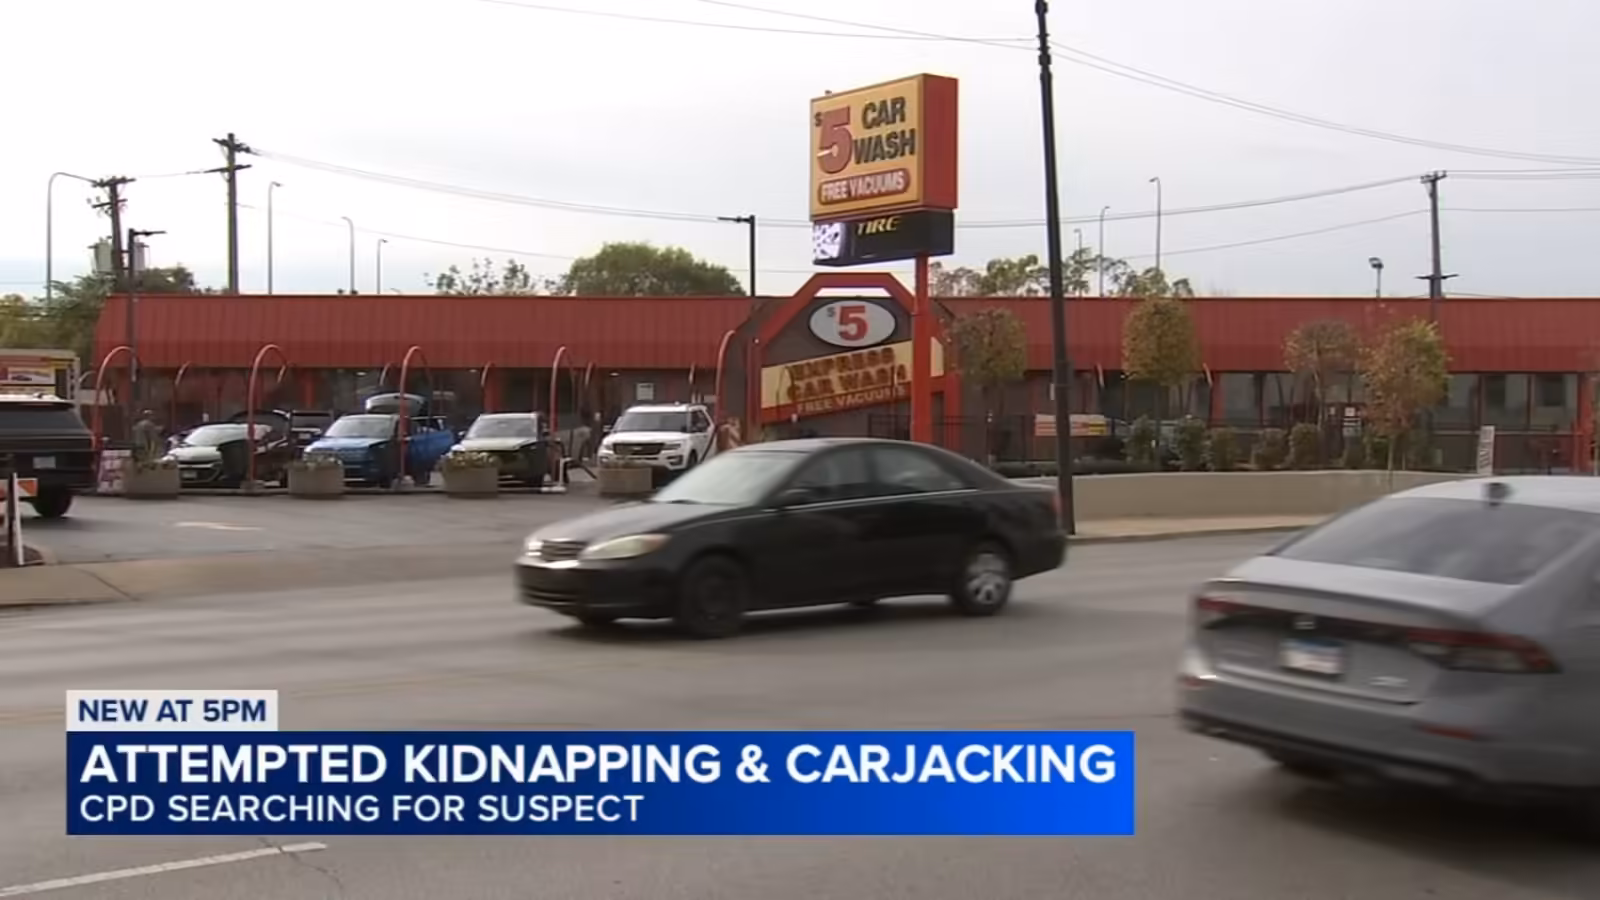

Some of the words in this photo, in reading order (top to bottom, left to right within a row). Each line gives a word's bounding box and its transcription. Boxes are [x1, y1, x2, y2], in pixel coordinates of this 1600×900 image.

[862, 97, 906, 130] CAR
[853, 128, 916, 165] WASH
[821, 180, 848, 200] FREE
[849, 170, 905, 198] VACUUMS
[857, 215, 901, 236] TIRE
[827, 305, 869, 341] $5
[797, 400, 833, 414] FREE
